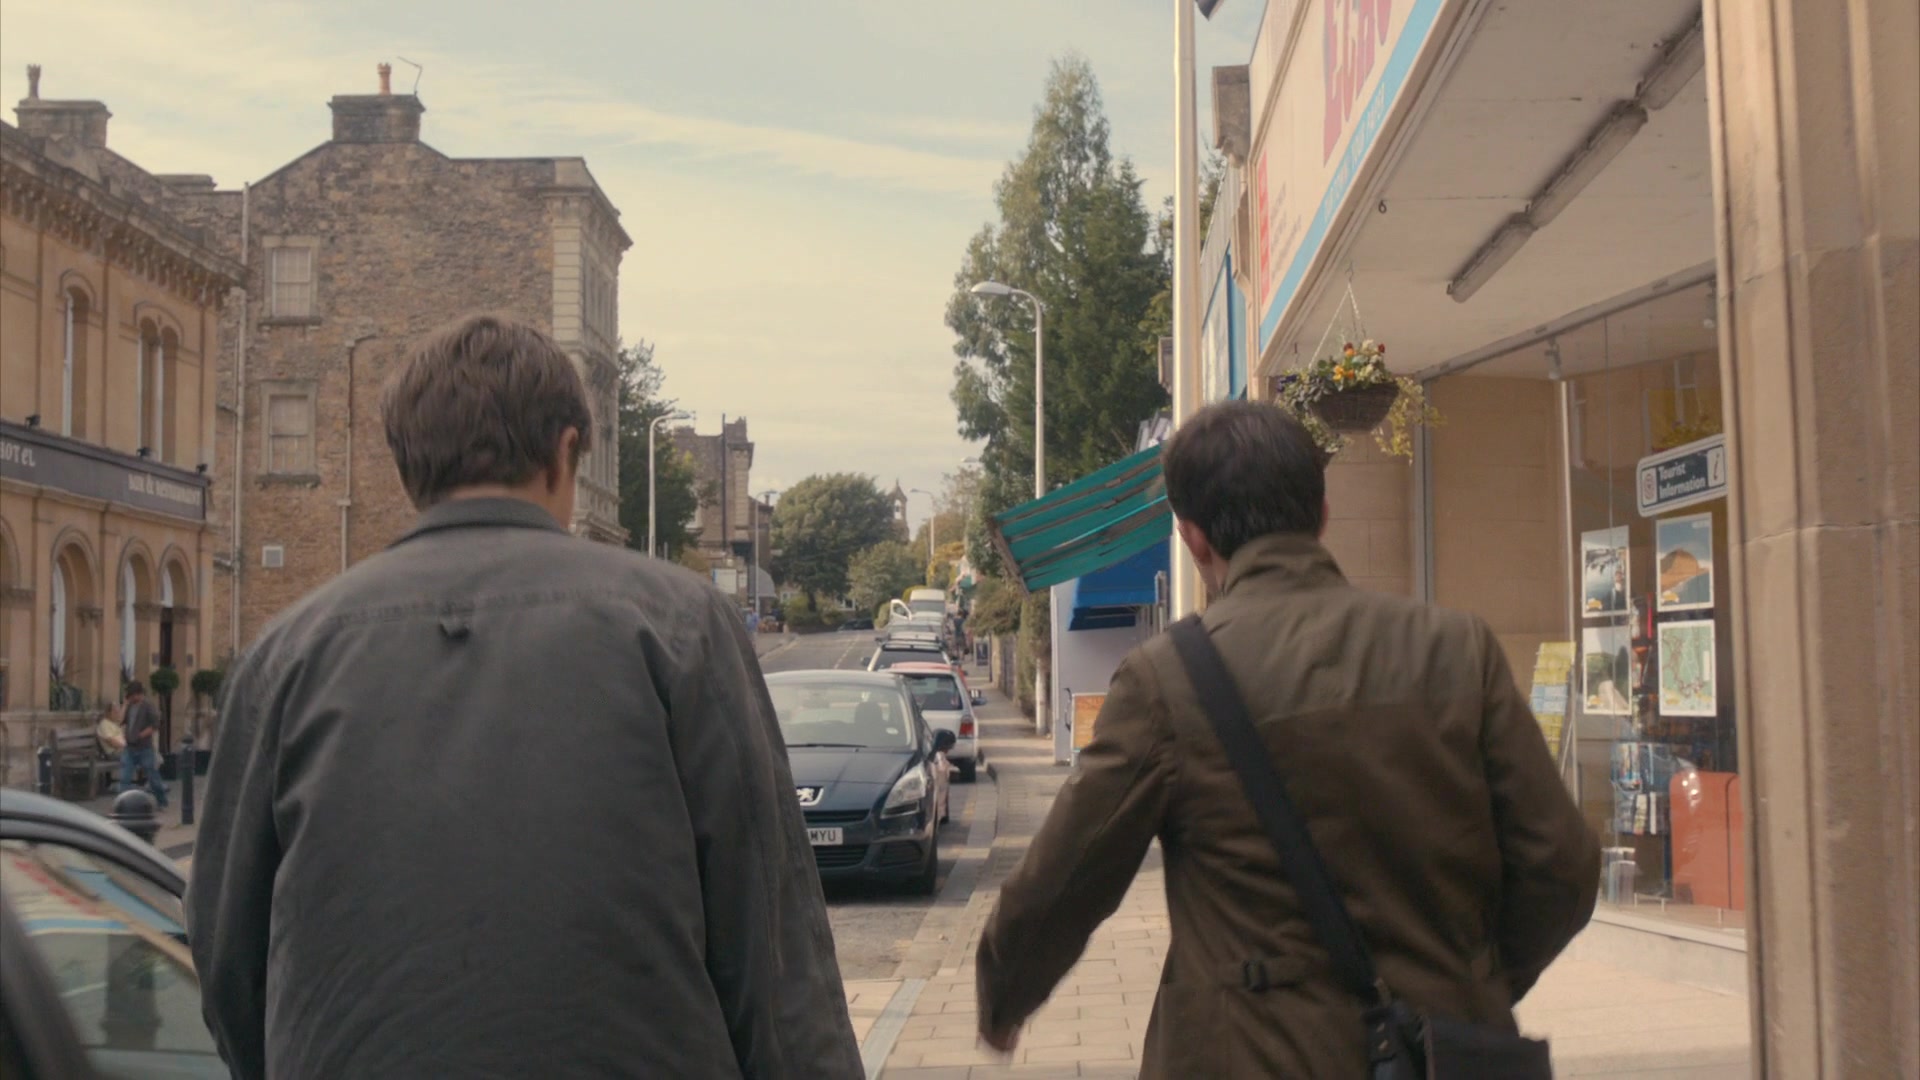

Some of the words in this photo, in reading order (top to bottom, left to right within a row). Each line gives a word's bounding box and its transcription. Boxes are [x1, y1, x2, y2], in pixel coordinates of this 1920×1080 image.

[1323, 0, 1392, 168] EC
[1658, 461, 1686, 481] Tourist
[1660, 474, 1706, 499] Information
